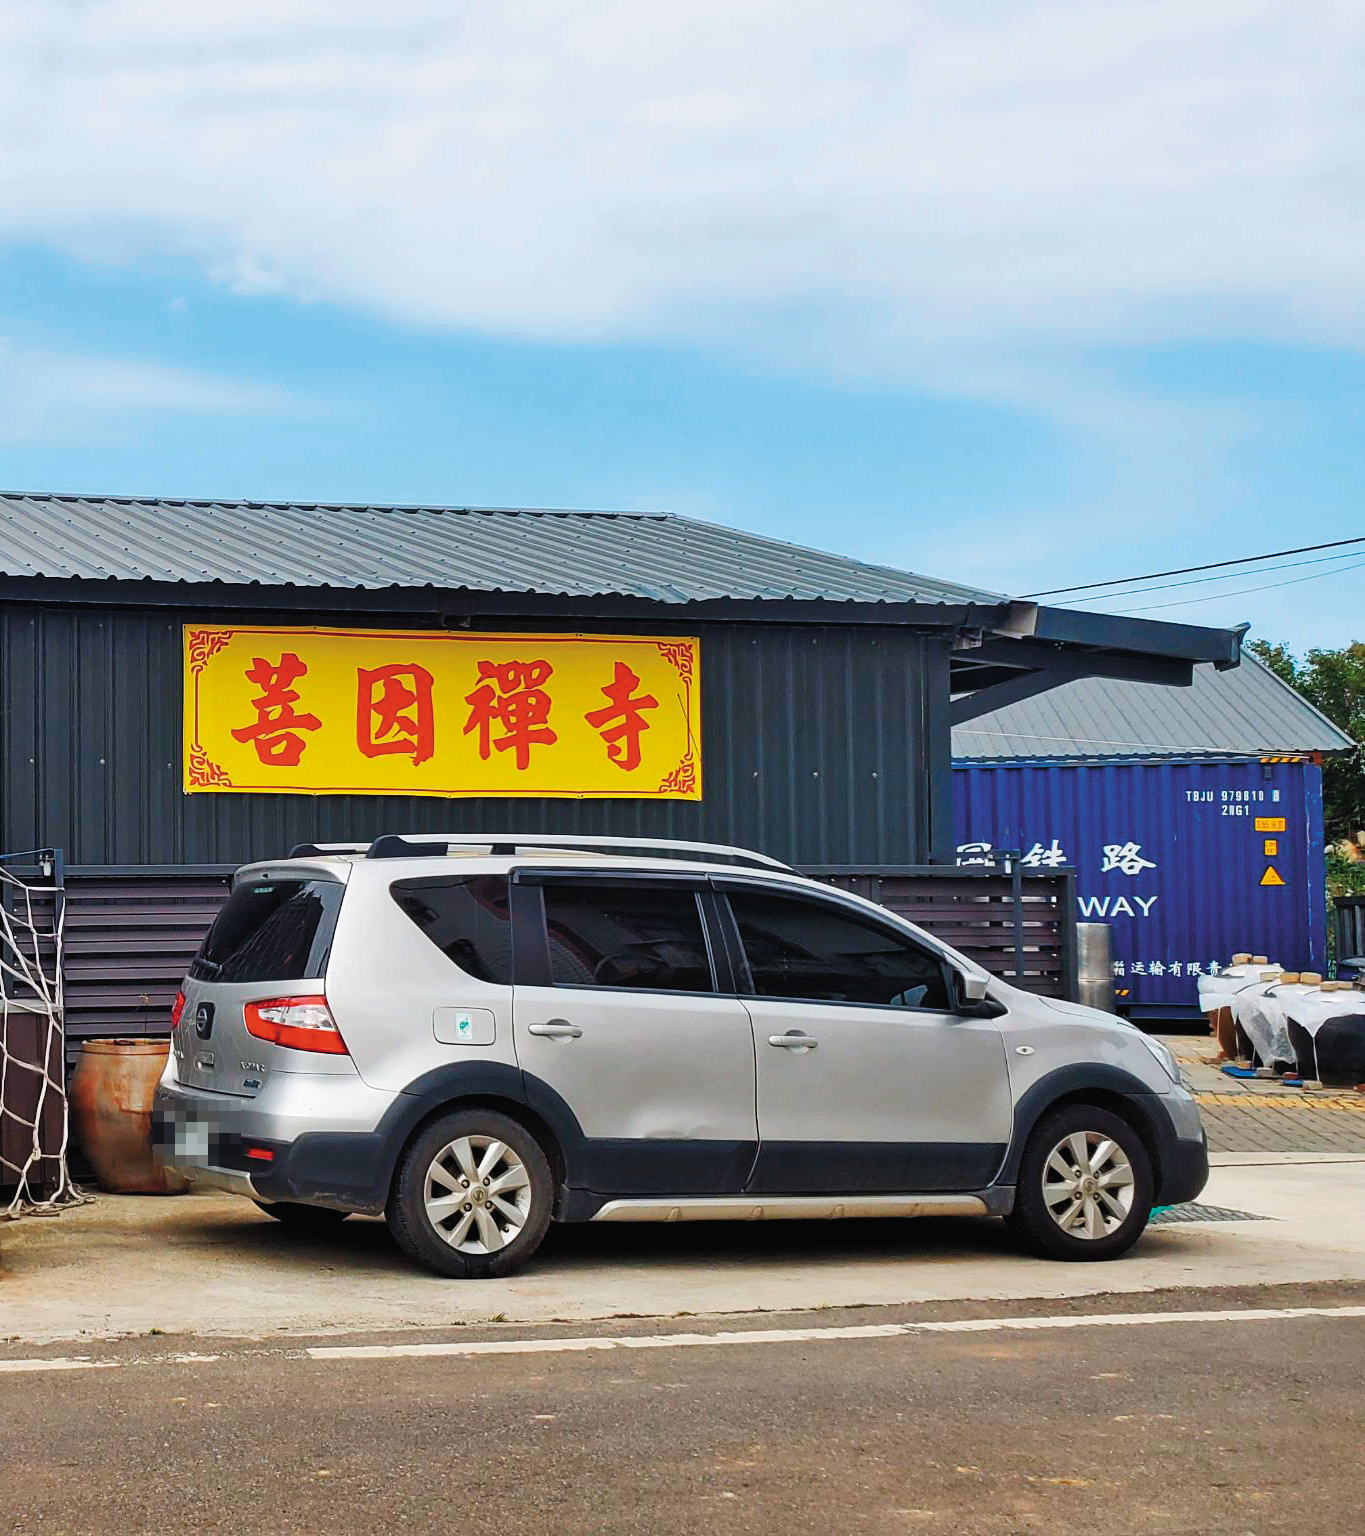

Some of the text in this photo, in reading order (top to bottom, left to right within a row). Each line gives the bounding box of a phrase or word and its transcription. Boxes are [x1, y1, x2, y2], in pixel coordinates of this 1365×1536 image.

[231, 652, 659, 771] 菩因禪寺
[1186, 790, 1213, 802] TBJU
[1221, 790, 1264, 802] 979810
